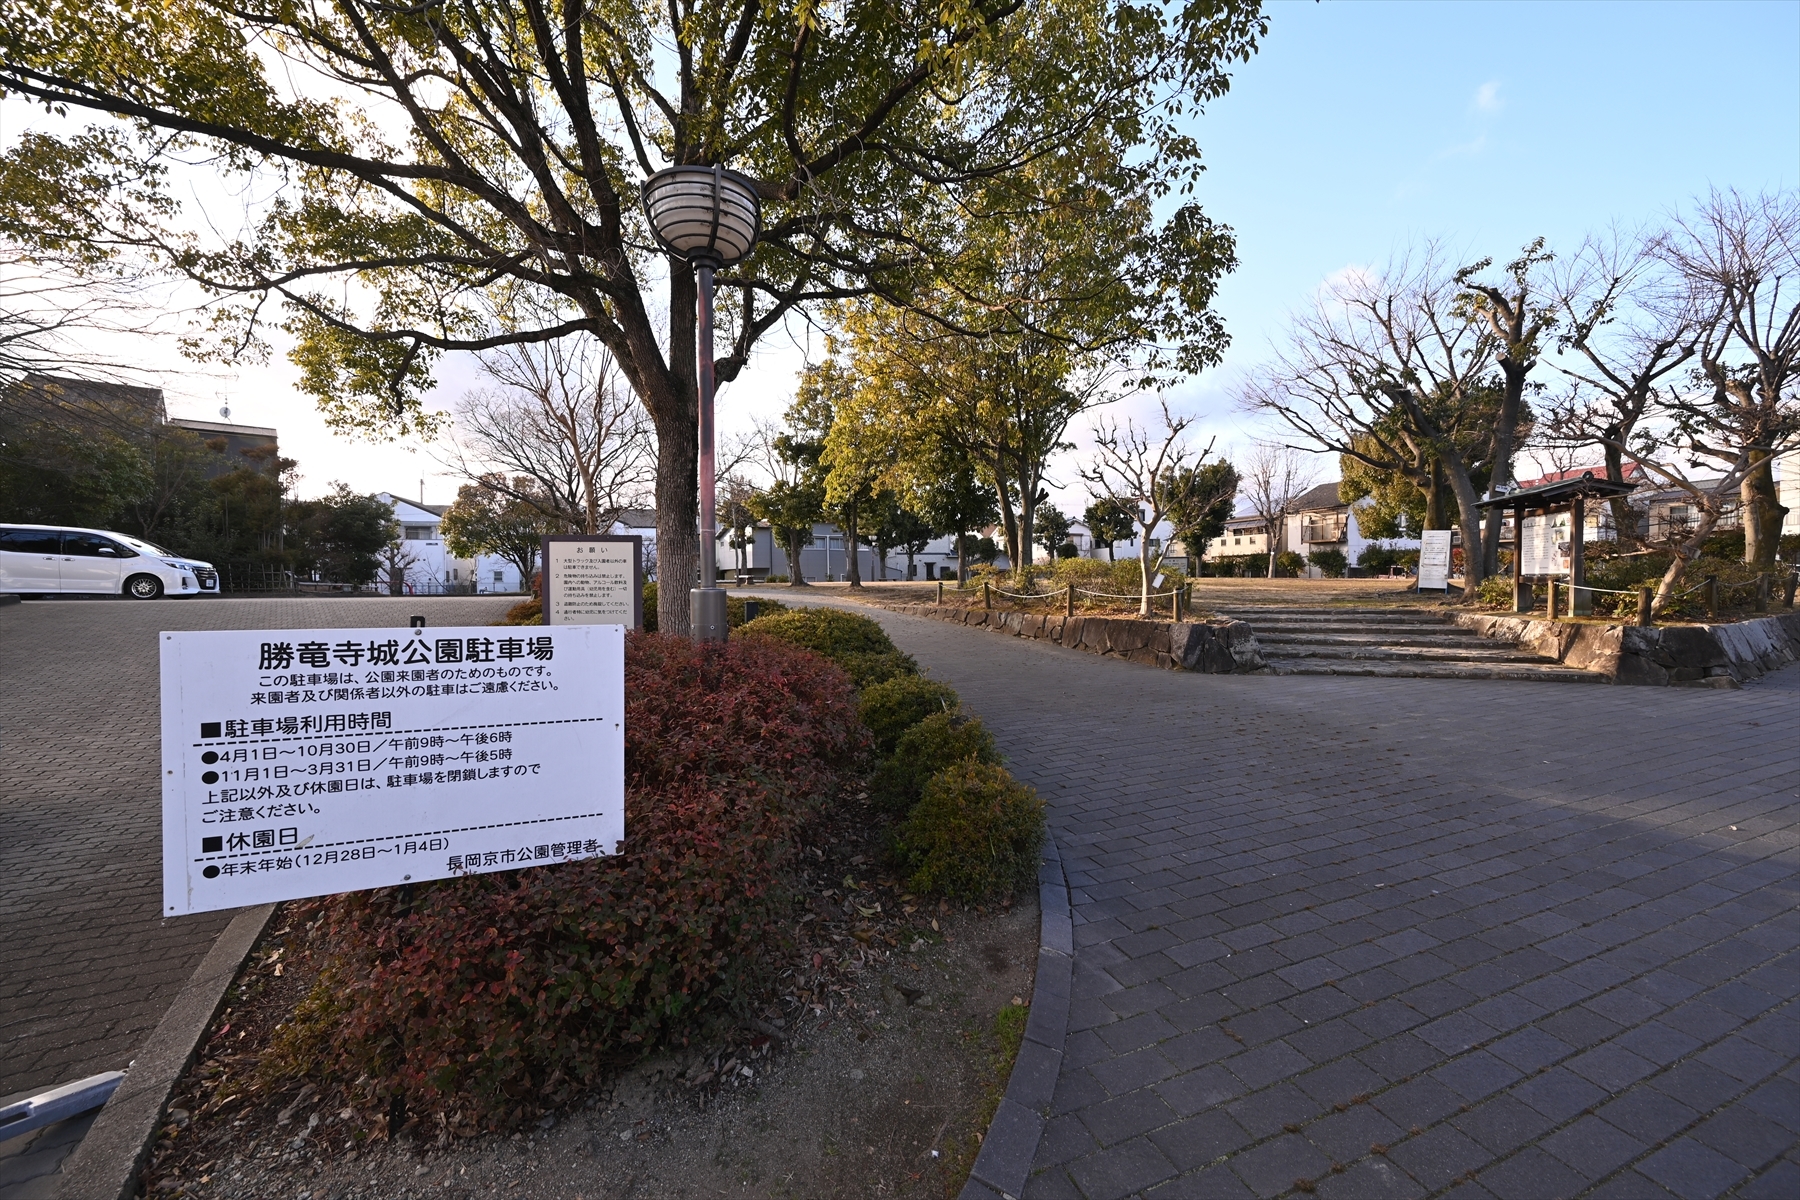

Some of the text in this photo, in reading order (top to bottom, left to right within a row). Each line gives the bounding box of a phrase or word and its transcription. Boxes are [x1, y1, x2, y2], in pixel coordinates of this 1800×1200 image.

[258, 636, 554, 670] 勝竜寺城公園駐車場
[259, 665, 552, 687] この駐車場は、公園来園者のためのものです。
[250, 680, 559, 705] 来園者及び関係者以外の駐車はご遠慮ください。
[224, 711, 391, 738] 駐車場利用時間
[201, 763, 541, 805] 上記以外及び休園日は、駐車場を閉鎖しますので
[202, 803, 321, 824] ご注意ください。
[226, 827, 298, 852] 休園日
[447, 838, 598, 871] 長岡京市公園管理者
